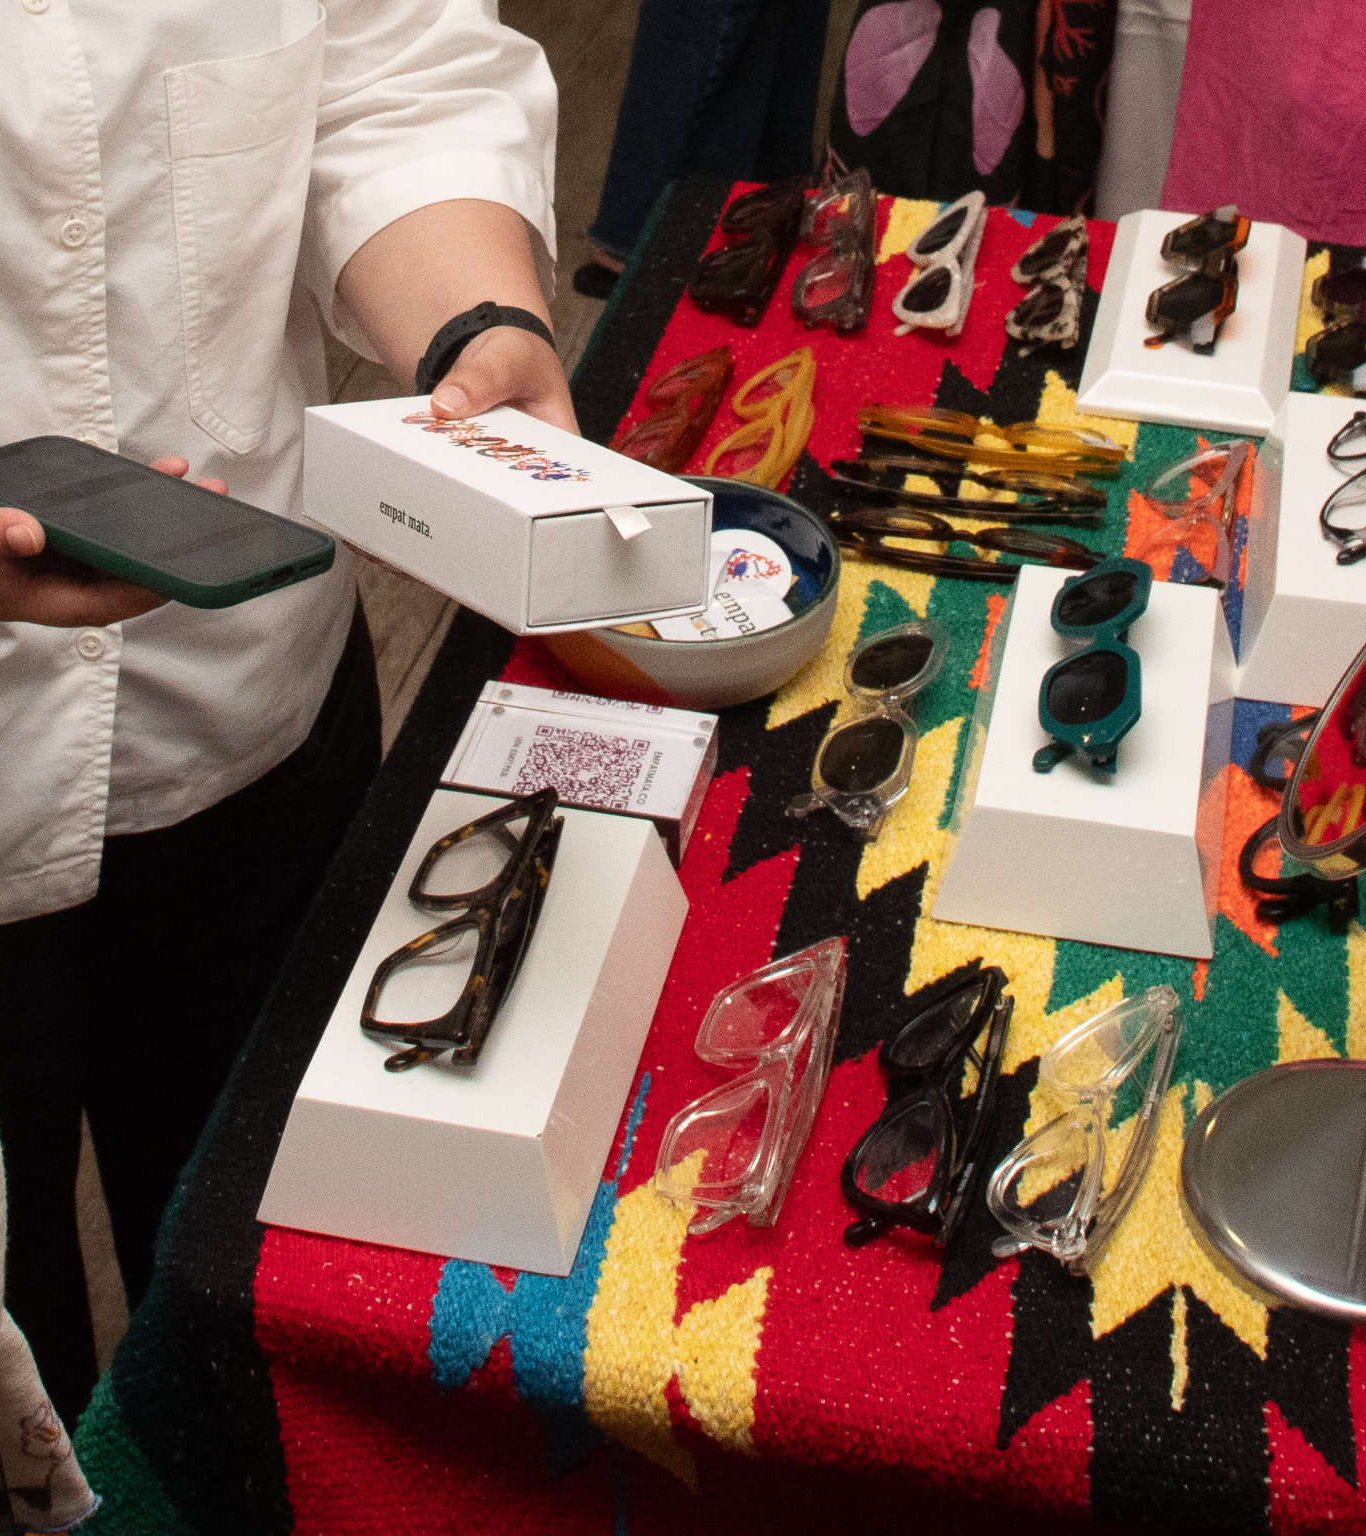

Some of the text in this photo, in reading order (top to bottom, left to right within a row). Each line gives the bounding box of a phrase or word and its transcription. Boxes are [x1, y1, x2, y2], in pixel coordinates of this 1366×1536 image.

[379, 501, 433, 539] empat mata.
[714, 592, 756, 636] empa
